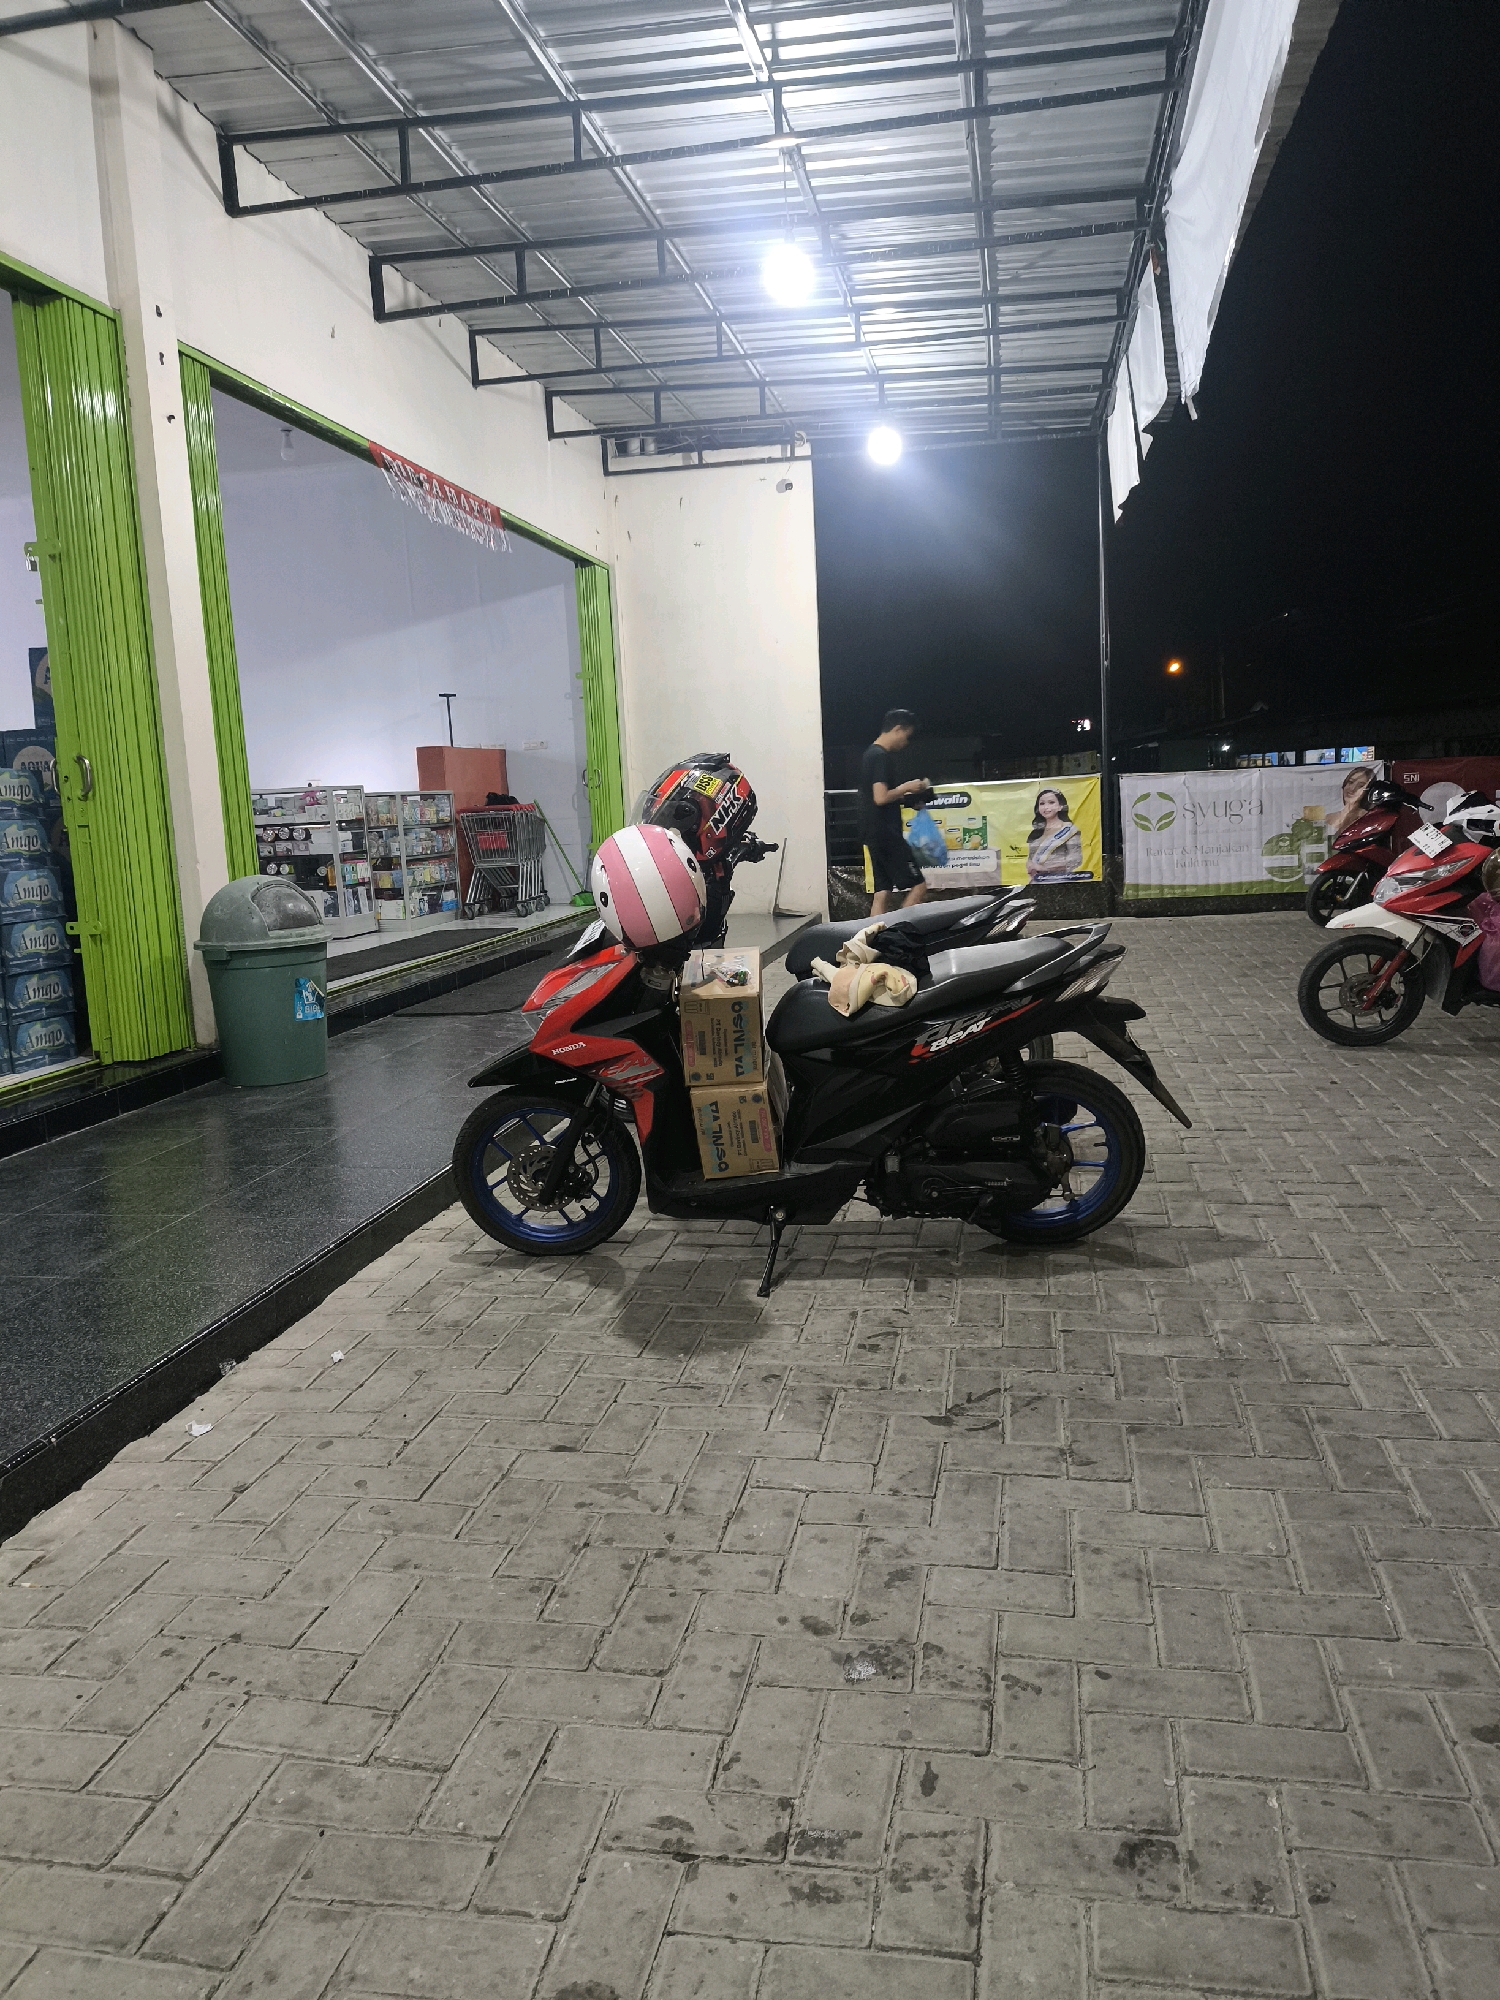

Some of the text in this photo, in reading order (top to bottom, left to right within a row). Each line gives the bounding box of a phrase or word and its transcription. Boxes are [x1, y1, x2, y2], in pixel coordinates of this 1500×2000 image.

[1403, 772, 1420, 784] SNI
[710, 785, 743, 835] NHK
[551, 1041, 587, 1056] HONDA
